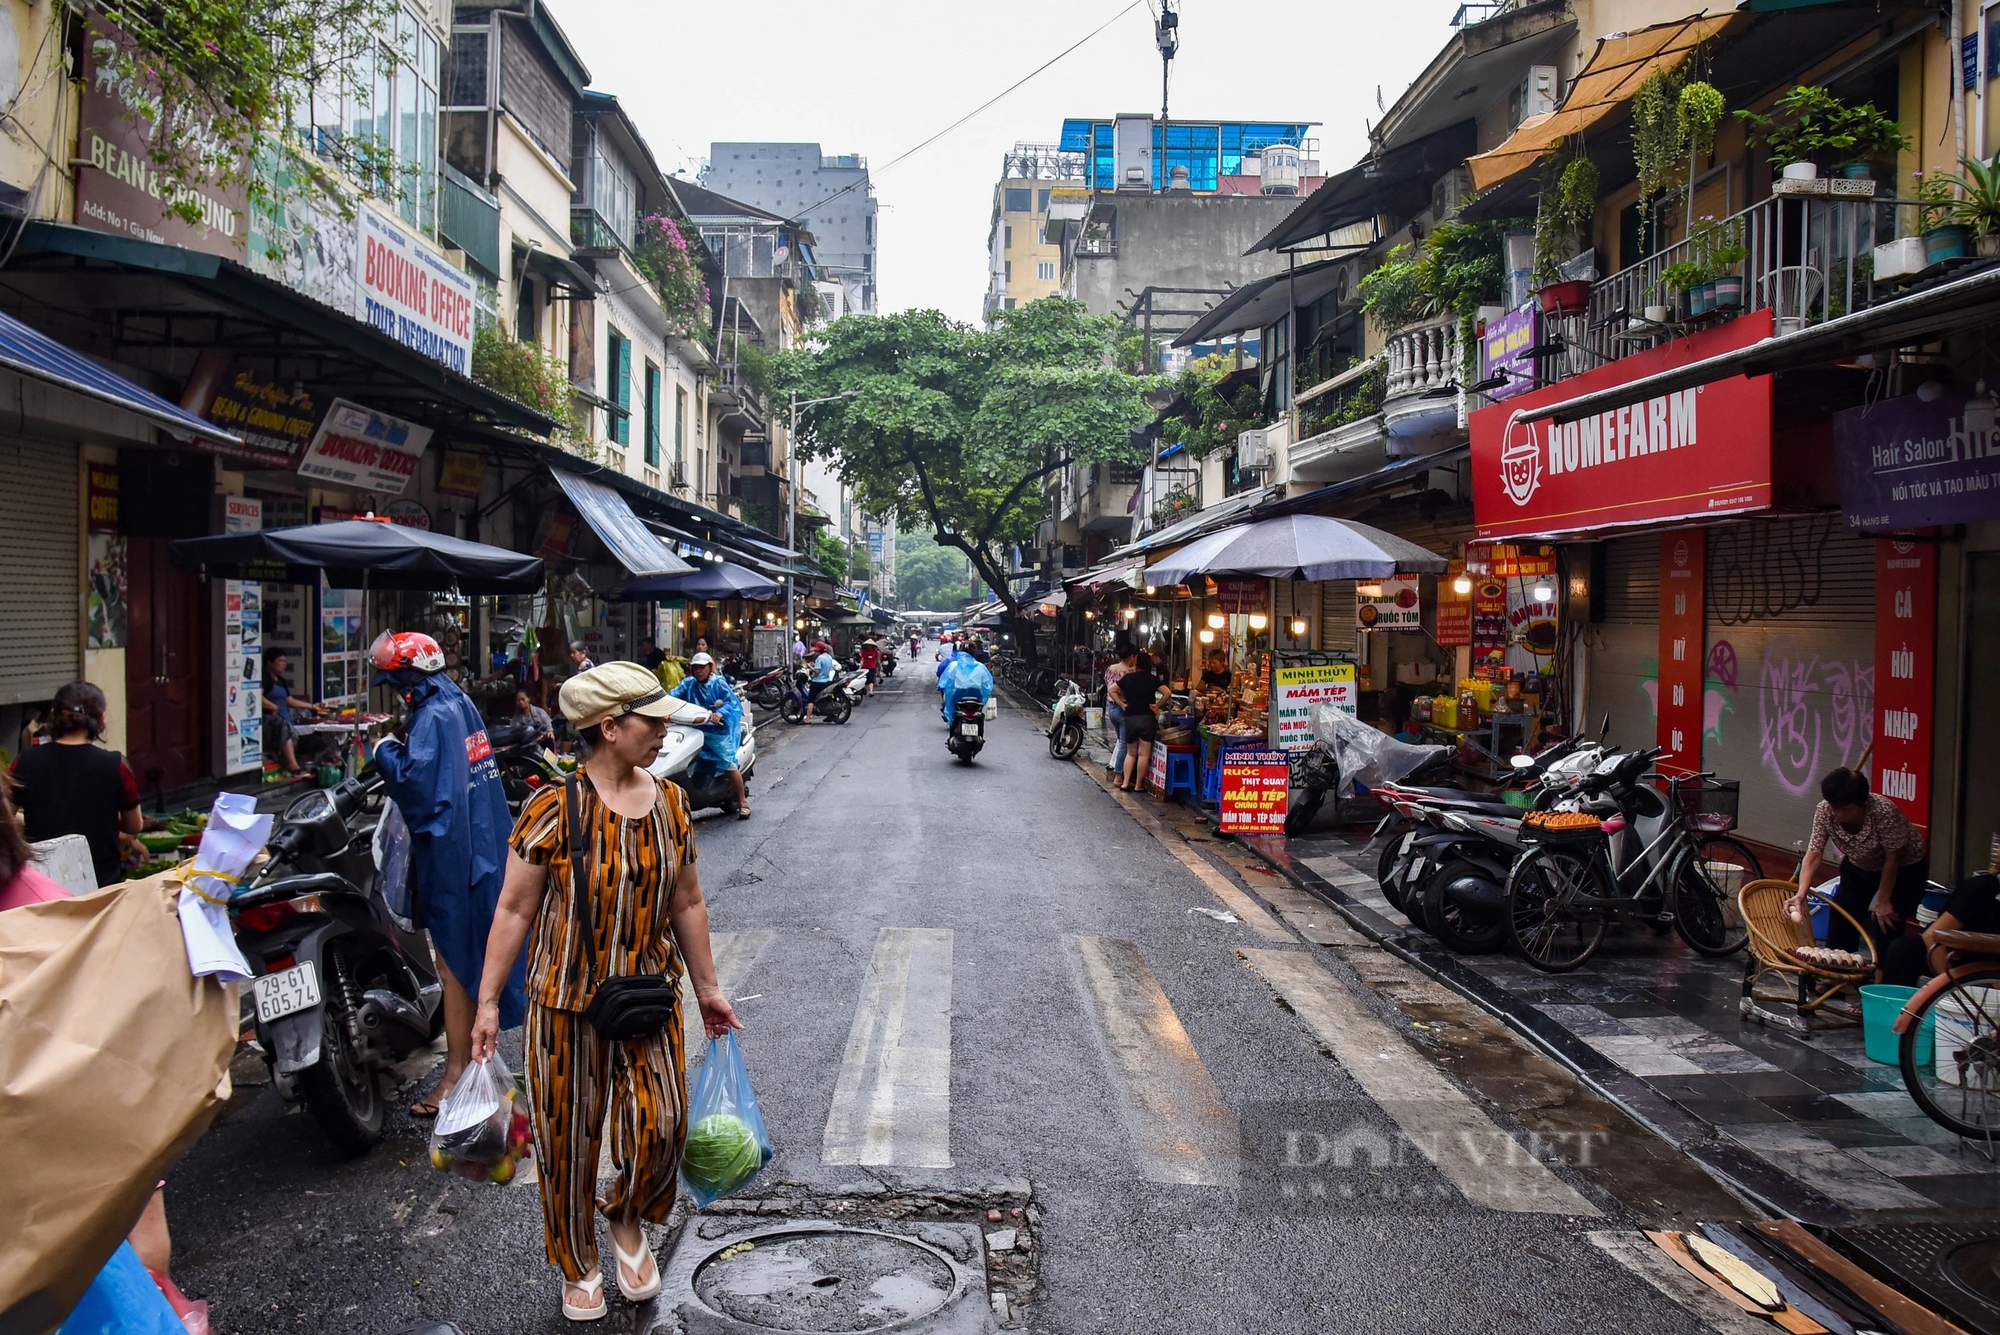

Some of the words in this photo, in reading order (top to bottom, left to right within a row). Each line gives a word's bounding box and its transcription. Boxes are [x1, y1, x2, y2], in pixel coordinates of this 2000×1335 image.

[91, 135, 146, 192] BEAN
[148, 171, 161, 200] &
[83, 200, 106, 220] Add:
[108, 211, 121, 227] No
[130, 222, 145, 239] Gia
[366, 235, 427, 316] BOOKING
[431, 278, 471, 341] OFFICE
[366, 296, 396, 340] TOUR
[399, 313, 466, 375] INFORMATION
[1548, 387, 1697, 476] HOMEFARM
[318, 432, 380, 466] BOOKING
[1872, 443, 1899, 467] Hair
[1904, 437, 1944, 463] Salon
[1892, 481, 1908, 501] NỐI
[1929, 478, 1942, 496] VÀ
[1944, 480, 1963, 496] TẠO
[229, 503, 259, 517] SERVICES
[1850, 515, 1861, 527] 34
[1862, 516, 1880, 527] HÀNG
[1887, 558, 1921, 569] HOMEFARM
[1895, 586, 1912, 618] CÁ
[1378, 609, 1399, 623] RUỐC
[1402, 612, 1418, 622] TÔM
[1509, 603, 1543, 627] MINH
[1891, 642, 1913, 679] HỒI
[1282, 670, 1315, 679] MINH
[1317, 667, 1347, 676] THỦY
[1323, 685, 1347, 696] TÉP
[1300, 732, 1314, 741] TÔM
[1884, 707, 1918, 744] NHẬP
[1671, 727, 1683, 752] ÚC
[1223, 767, 1260, 776] RUỐC
[1241, 778, 1260, 786] THỊT
[1882, 762, 1916, 801] KHẨU
[1223, 786, 1258, 800] MẮM
[1262, 789, 1286, 801] TÉP
[1257, 812, 1268, 823] TÉP
[1259, 802, 1274, 811] THỊT
[262, 968, 305, 998] 29-G1
[261, 985, 315, 1018] 605.74
